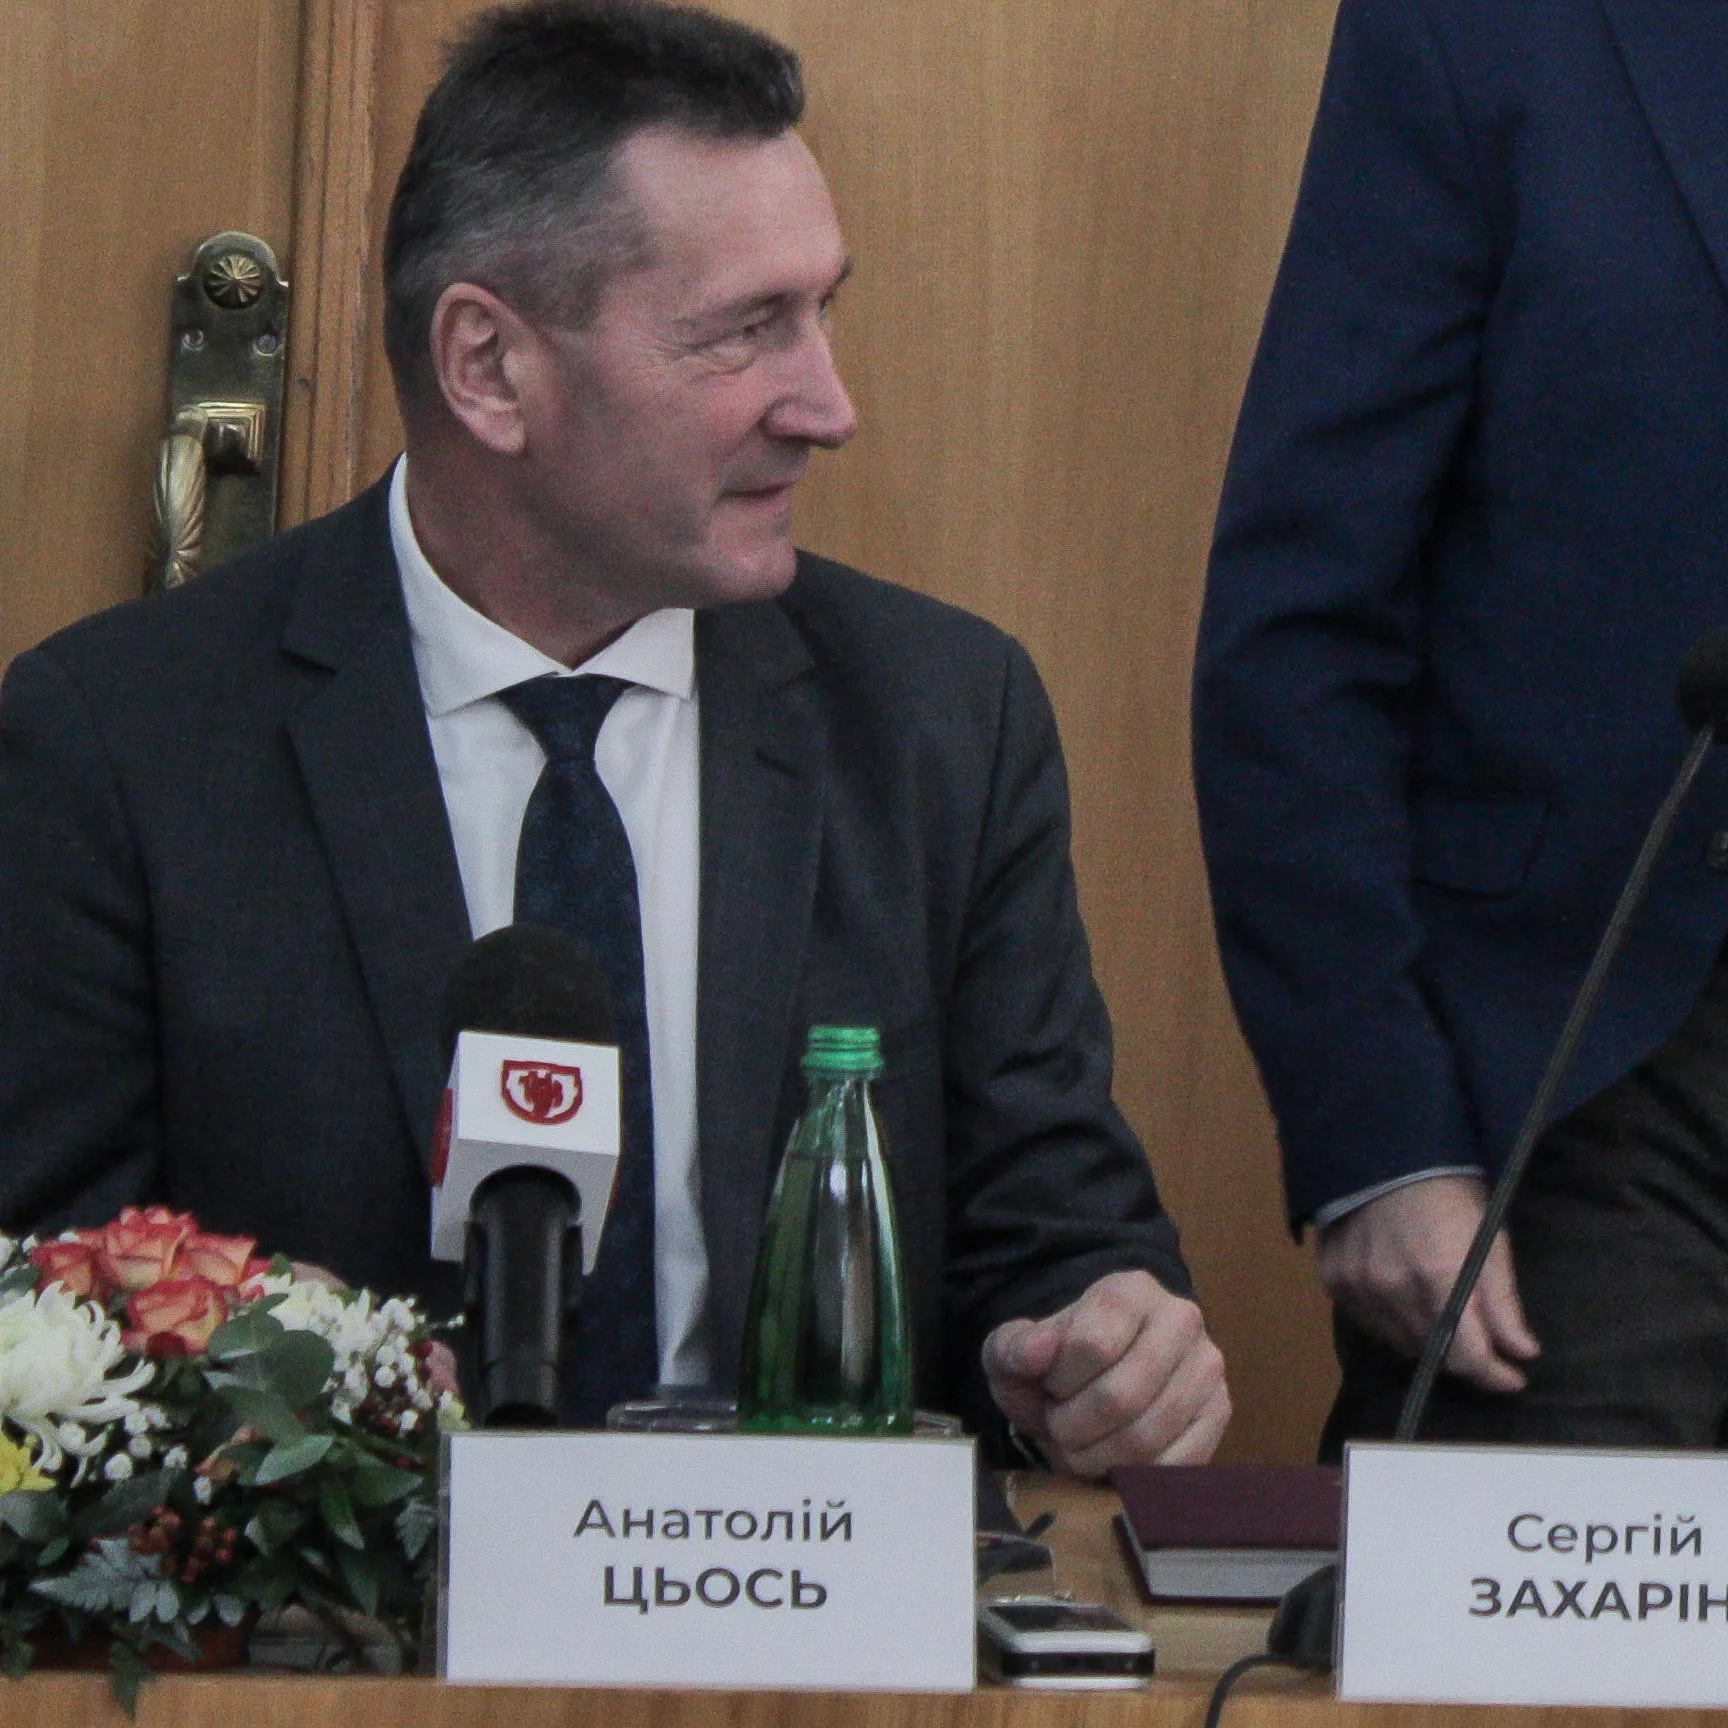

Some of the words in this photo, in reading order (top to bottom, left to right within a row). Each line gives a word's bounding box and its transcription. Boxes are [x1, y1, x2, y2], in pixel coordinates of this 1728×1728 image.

[573, 1498, 853, 1543] Анатолій
[1506, 1512, 1703, 1565] Сергій
[602, 1564, 829, 1615] ЦЬОСЬ
